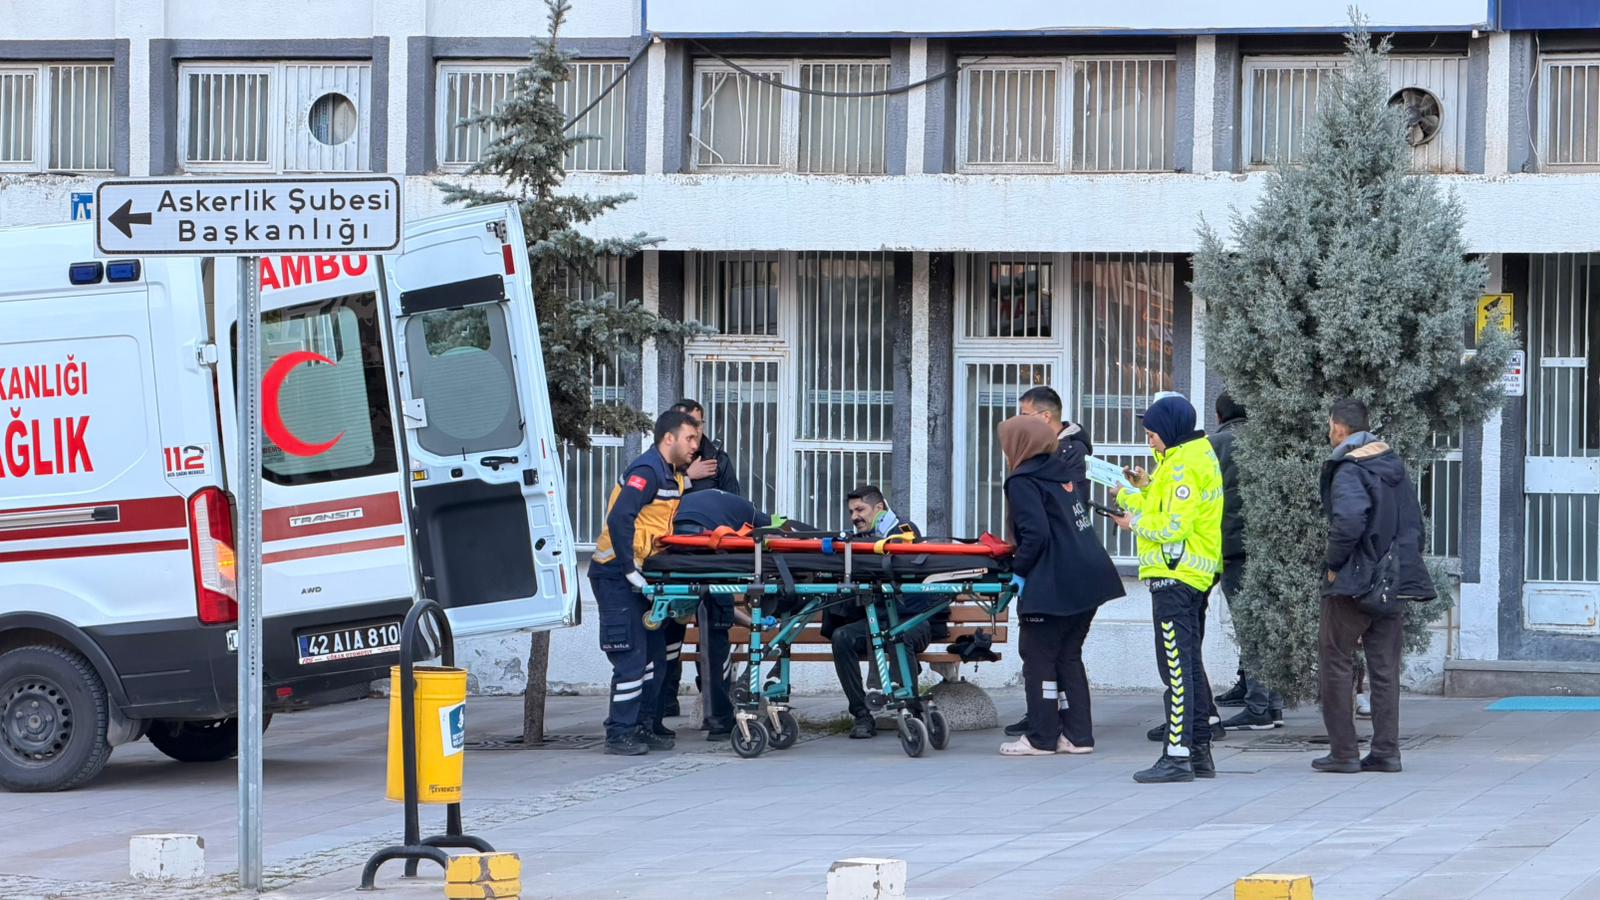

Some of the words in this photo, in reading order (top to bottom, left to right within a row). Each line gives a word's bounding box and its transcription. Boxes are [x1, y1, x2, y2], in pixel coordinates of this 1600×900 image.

[157, 189, 277, 212] Askerlik
[288, 187, 390, 214] Şubesi
[178, 217, 368, 246] Başkanlığı
[0, 406, 94, 478] ĞLIK
[163, 445, 204, 472] 112
[291, 509, 361, 526] TRANSIT
[301, 586, 322, 595] AWD
[309, 635, 330, 656] 42
[333, 629, 365, 653] AIA
[367, 624, 399, 647] 810
